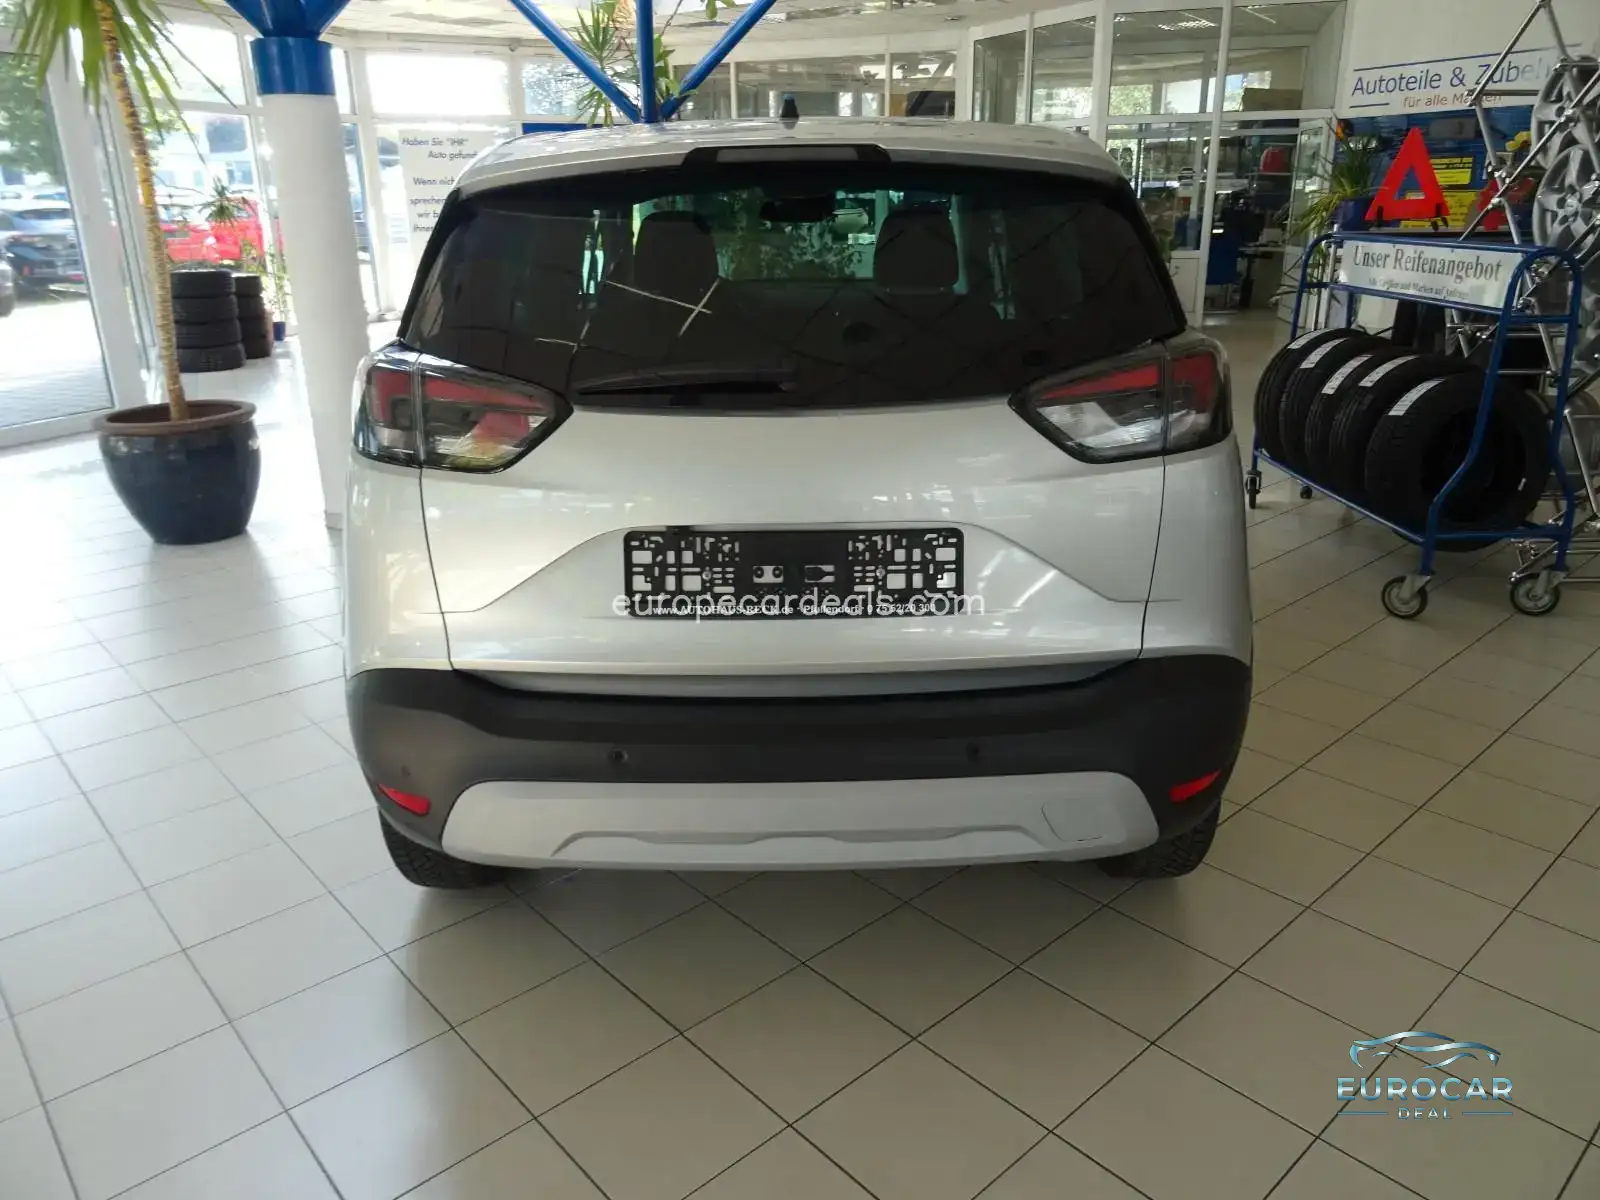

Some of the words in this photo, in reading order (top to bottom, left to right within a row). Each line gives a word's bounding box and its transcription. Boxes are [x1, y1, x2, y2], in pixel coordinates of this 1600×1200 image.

[1352, 68, 1442, 97] Autoteile
[1450, 66, 1466, 87] &
[1403, 95, 1422, 109] für
[1425, 92, 1448, 107] alle
[402, 137, 429, 146] Haben
[431, 137, 443, 146] Sie
[428, 150, 446, 159] Auto
[413, 177, 436, 185] Wenn
[1353, 245, 1390, 268] Unser
[1393, 247, 1502, 283] Reifenangebot
